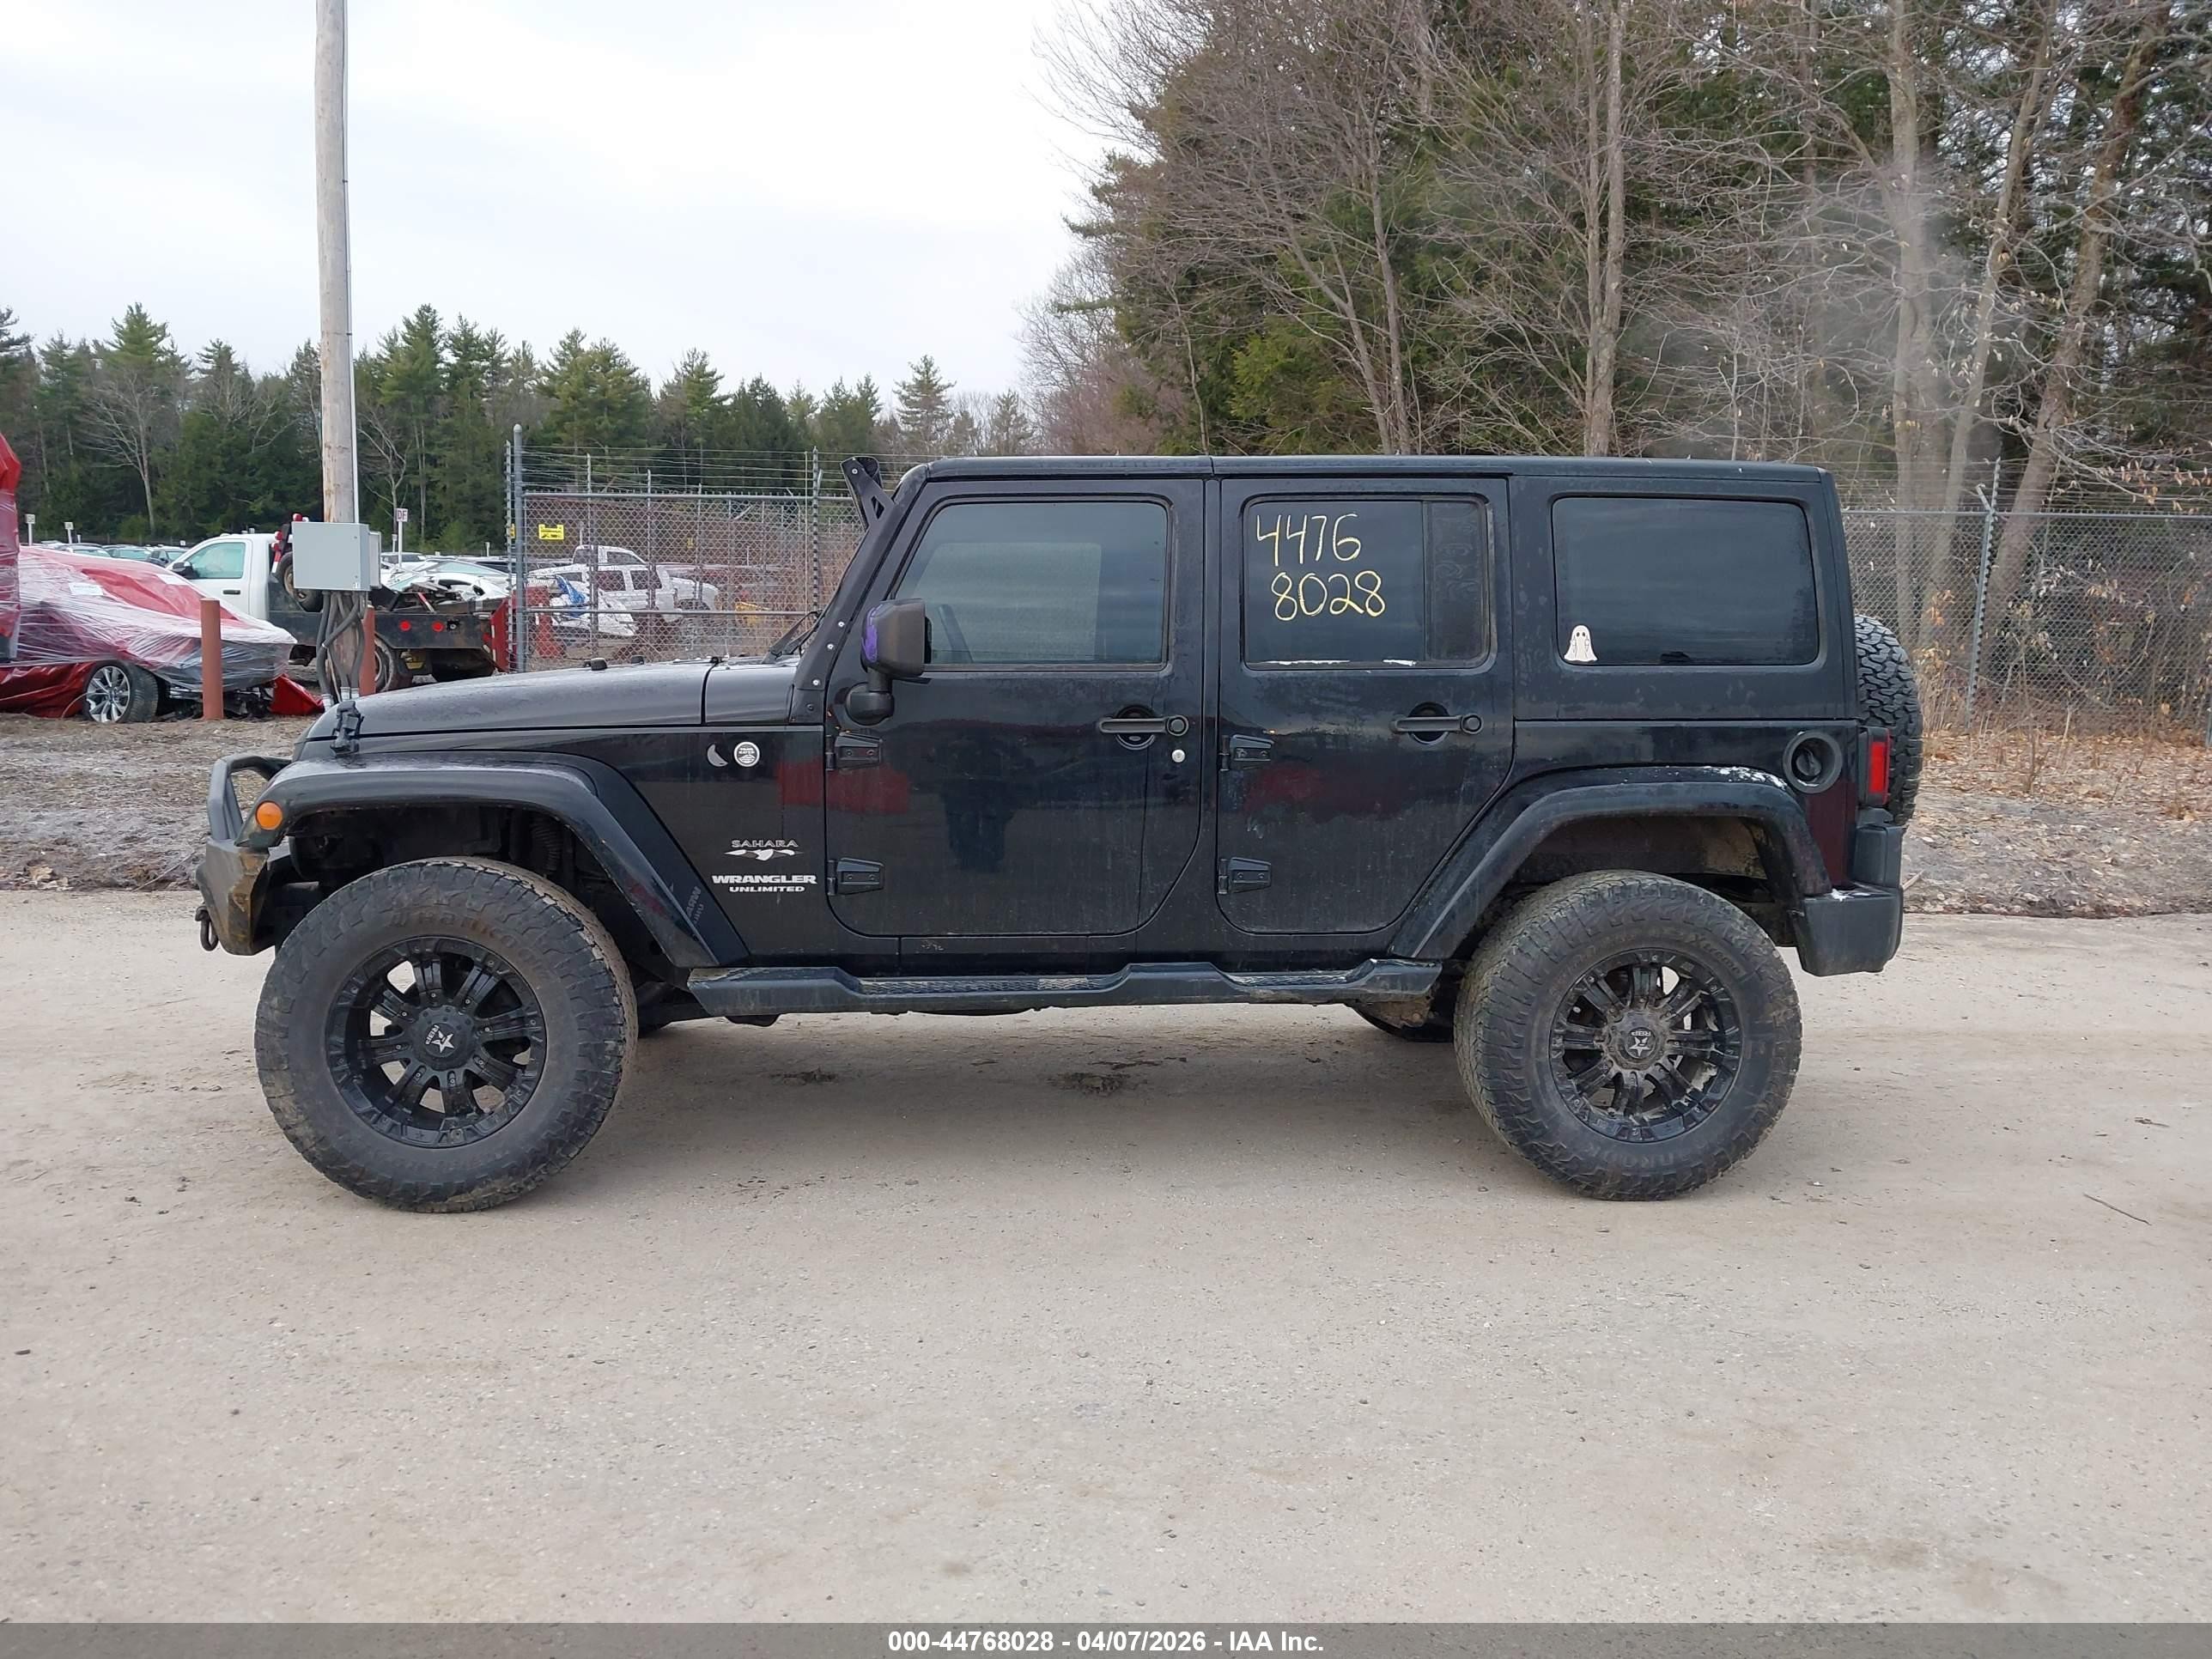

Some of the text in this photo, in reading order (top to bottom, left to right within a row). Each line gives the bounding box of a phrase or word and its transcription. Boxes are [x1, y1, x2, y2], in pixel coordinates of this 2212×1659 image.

[1256, 512, 1362, 567] 4476
[1271, 570, 1386, 621] 8028
[712, 874, 817, 884] WRANGLER
[425, 1024, 441, 1045] RBP
